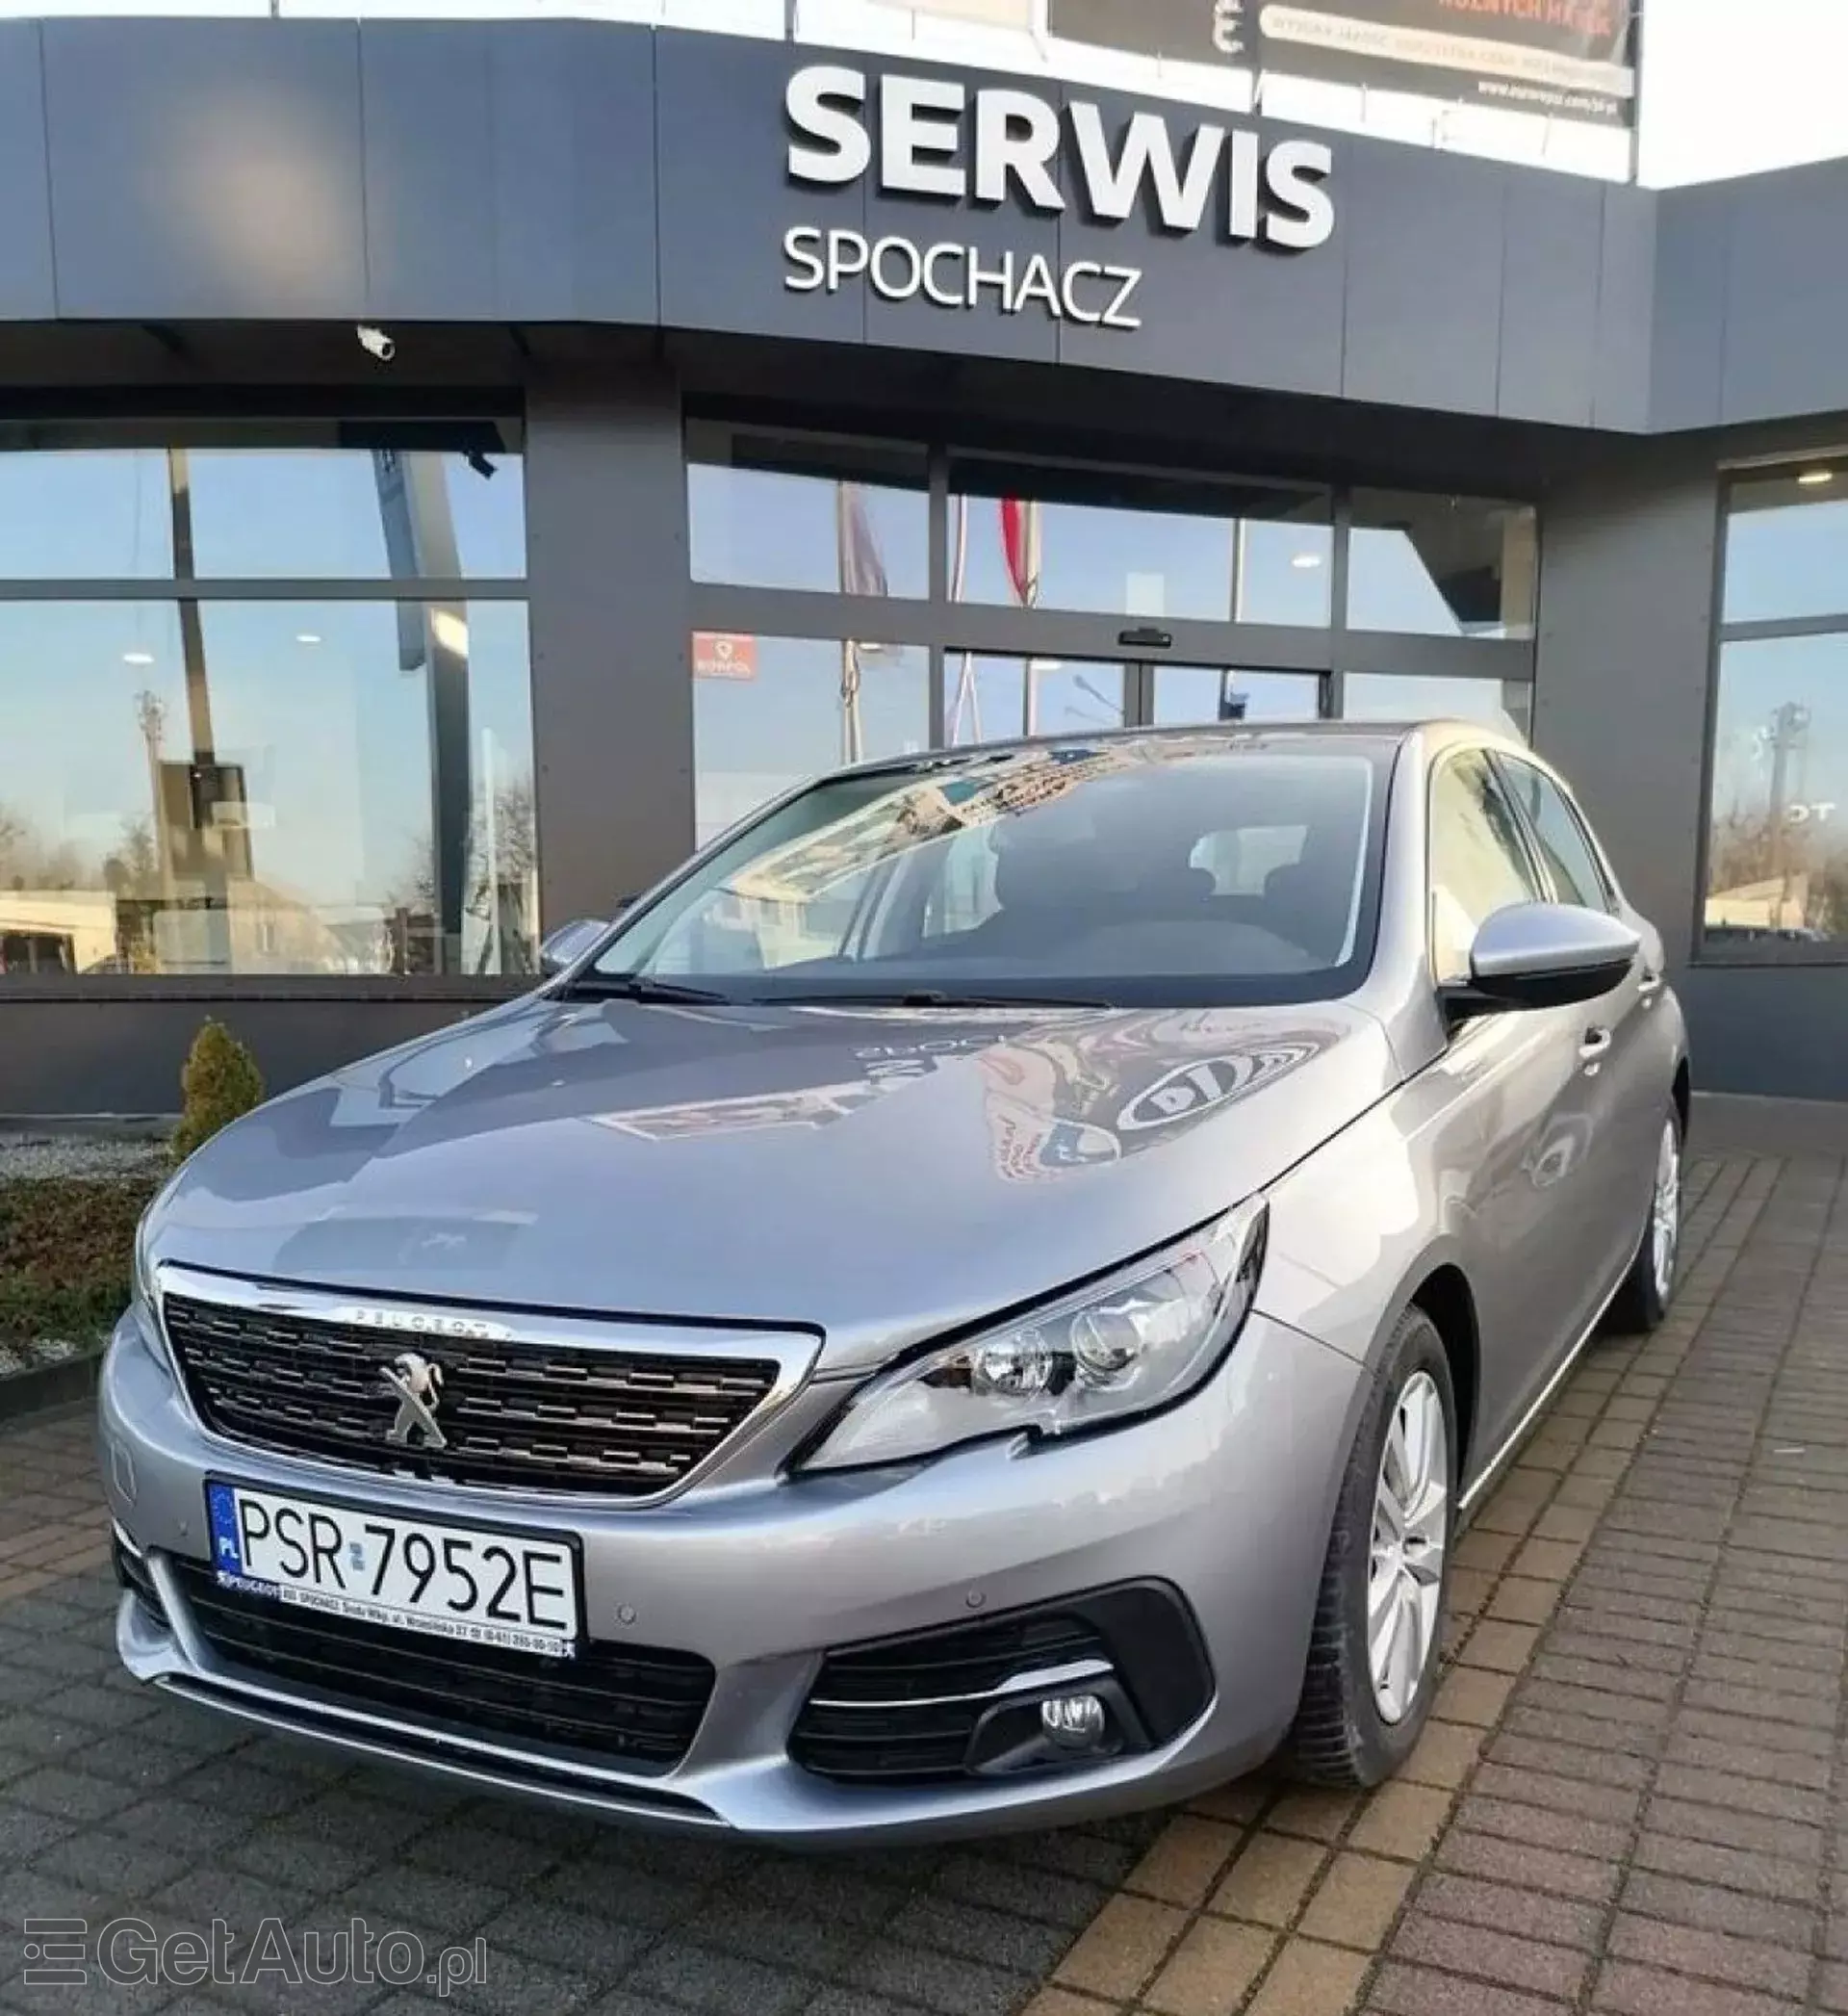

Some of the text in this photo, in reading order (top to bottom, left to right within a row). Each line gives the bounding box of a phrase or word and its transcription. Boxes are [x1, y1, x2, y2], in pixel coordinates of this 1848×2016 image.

[785, 65, 1336, 249] SERWIS
[783, 226, 1142, 328] SPOCHACZ
[240, 1498, 568, 1631] PSR 7952E
